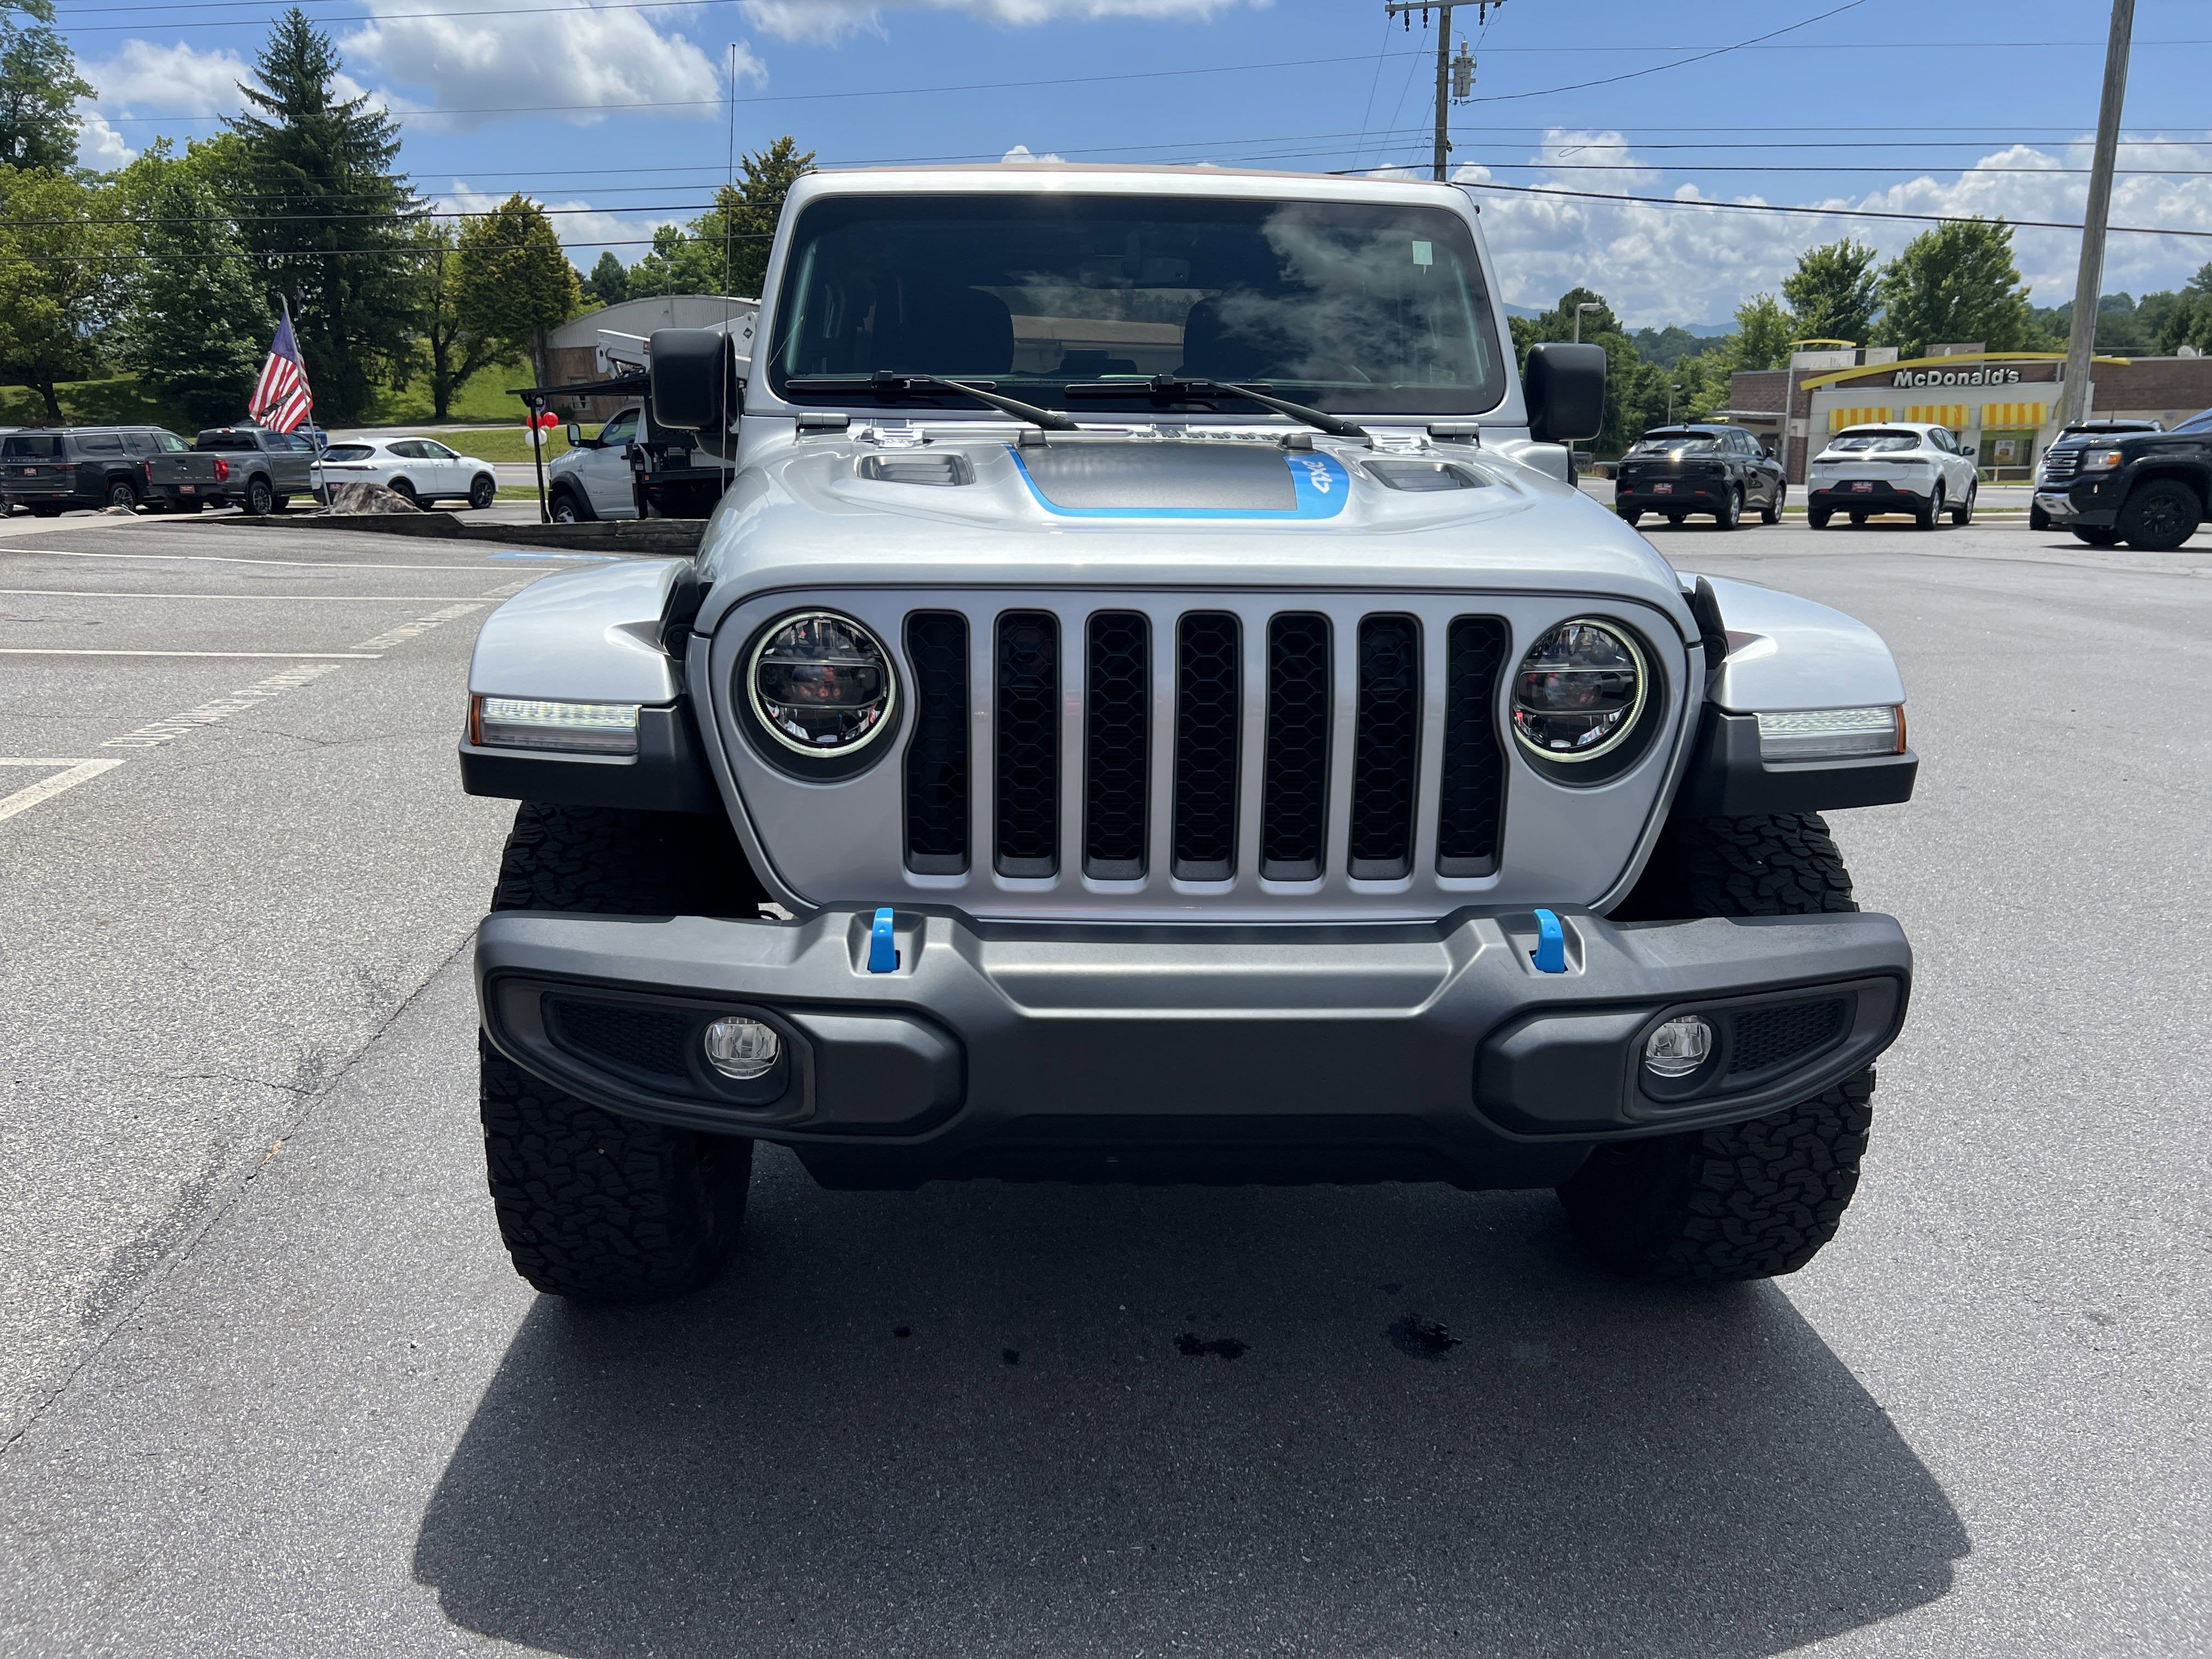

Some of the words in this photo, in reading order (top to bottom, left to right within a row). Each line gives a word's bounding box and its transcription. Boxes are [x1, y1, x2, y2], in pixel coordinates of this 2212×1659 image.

[1893, 369, 2019, 387] McDonald's
[99, 698, 267, 747] CUSTOMER
[230, 664, 341, 696] PARKING
